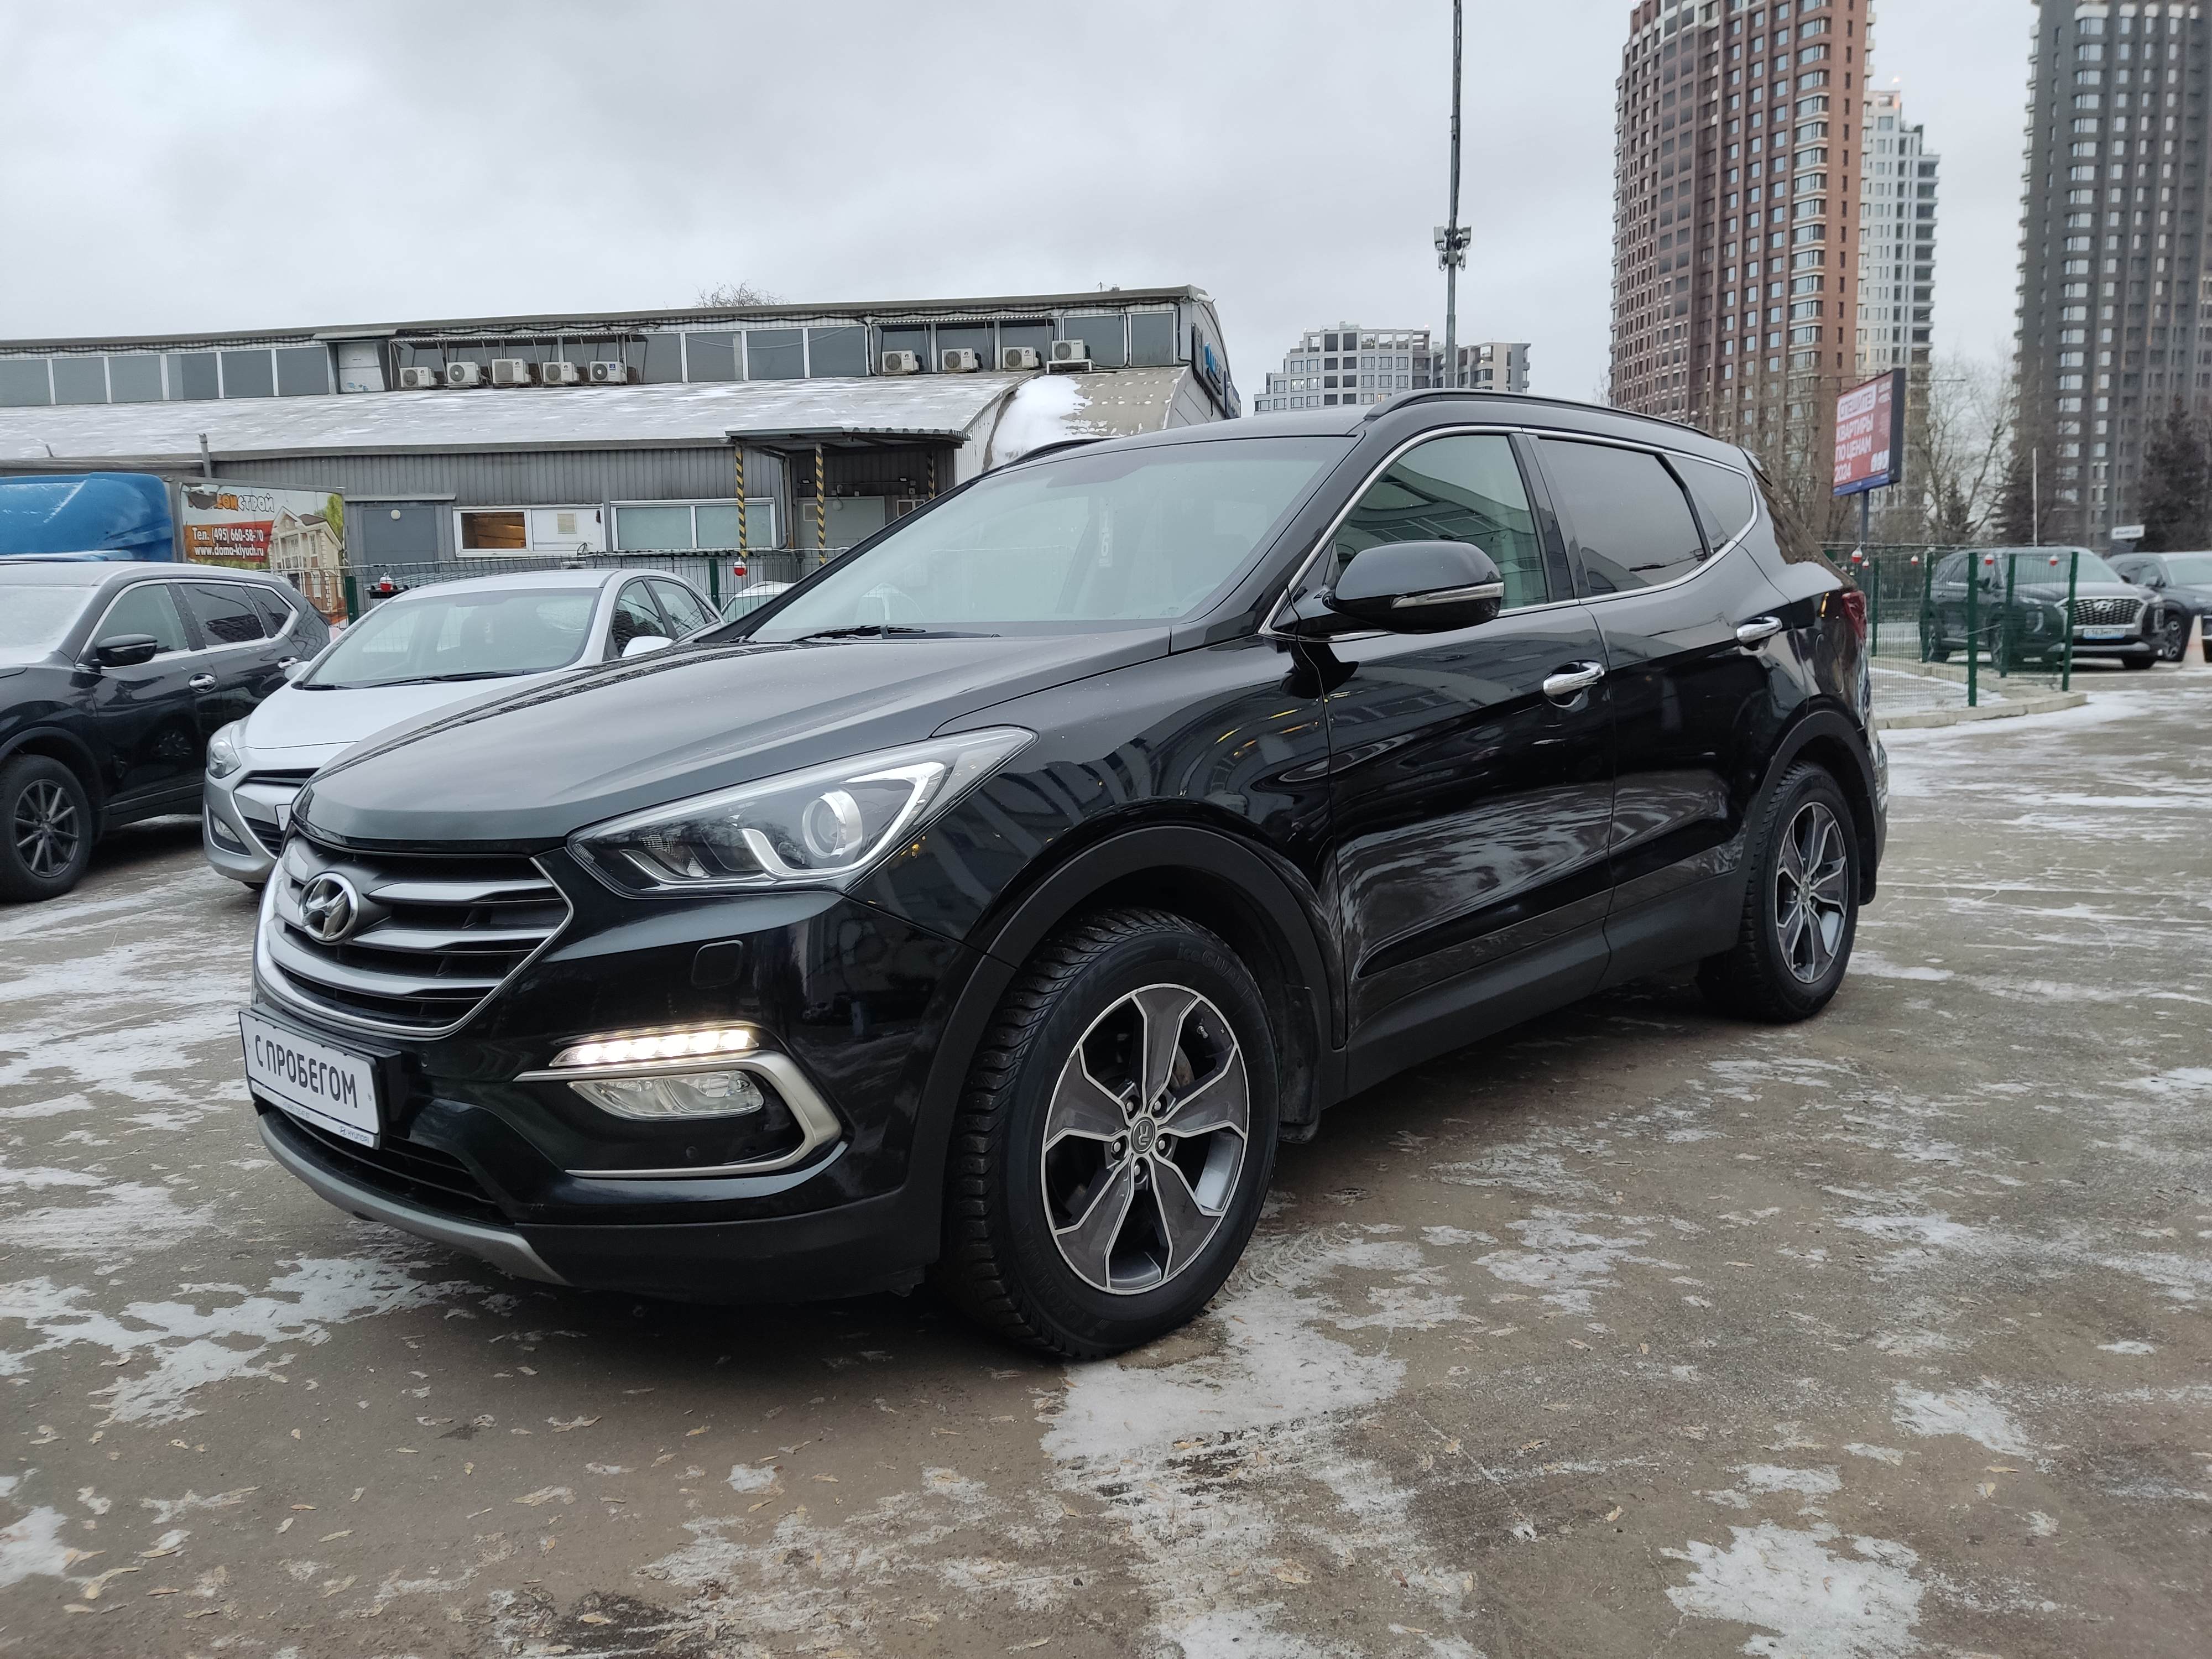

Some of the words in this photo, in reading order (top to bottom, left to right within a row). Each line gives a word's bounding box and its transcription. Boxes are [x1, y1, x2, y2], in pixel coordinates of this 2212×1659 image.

[1837, 414, 1874, 442] КВАРТИРЫ
[1835, 444, 1846, 462] ПО
[1847, 435, 1871, 460] ЦЕНАМ
[1834, 462, 1851, 483] 2024
[192, 527, 209, 540] Тел.
[212, 527, 229, 544] (495)
[194, 543, 264, 559] www.doma-klyuch.ru
[255, 1035, 264, 1067] С
[266, 1040, 358, 1109] ПРОБЕГОМ
